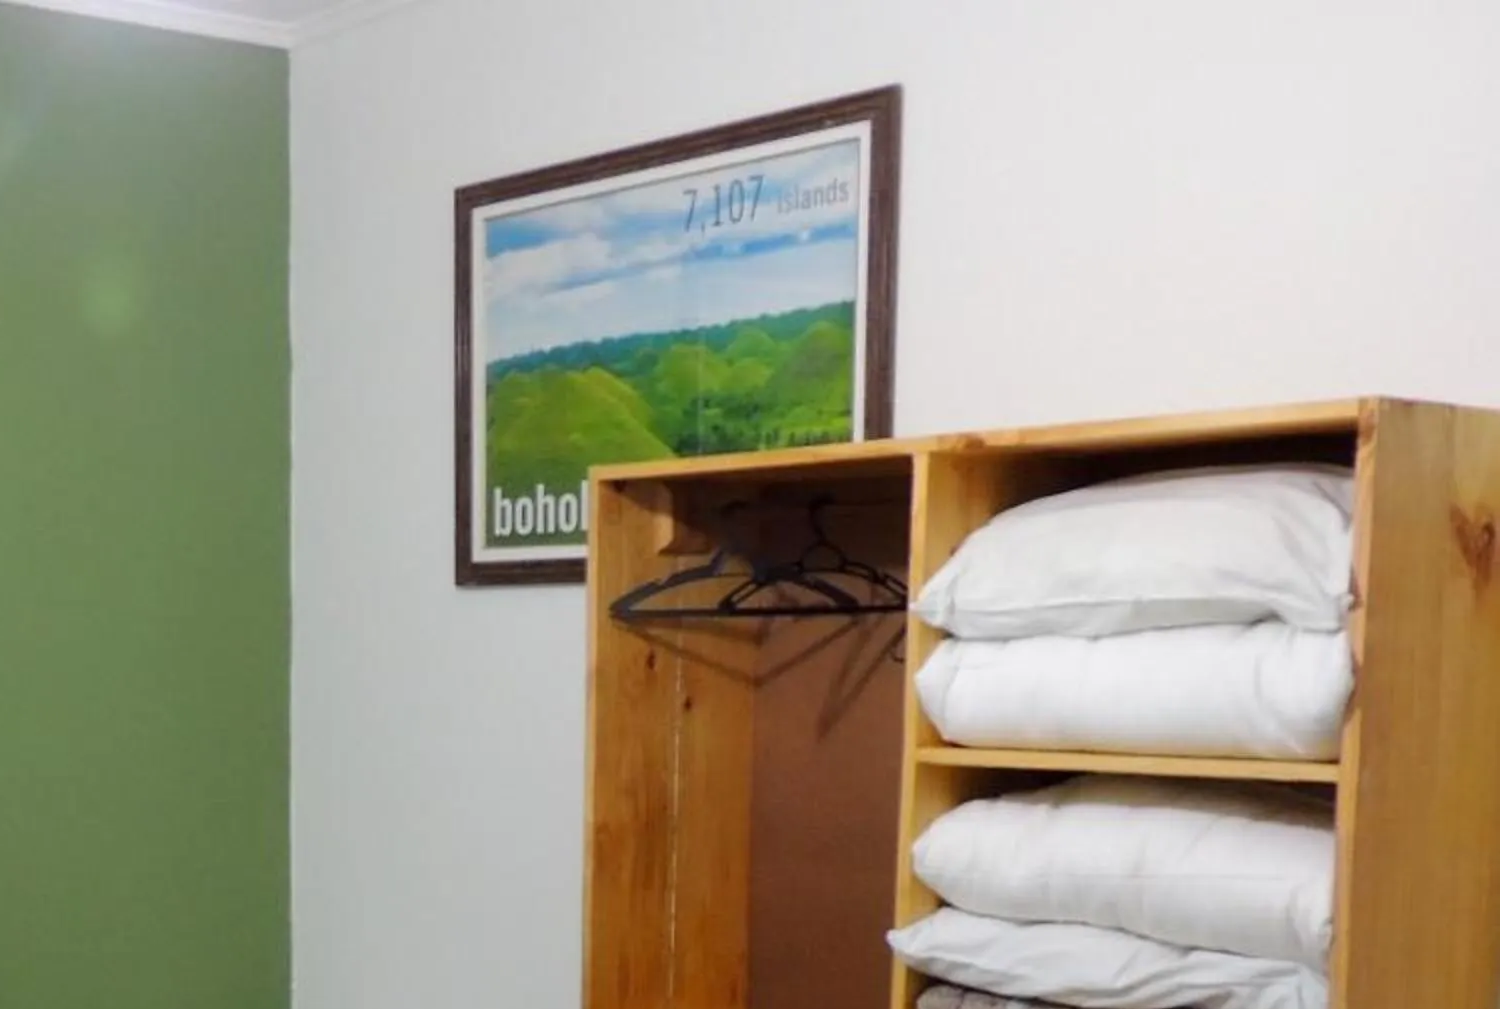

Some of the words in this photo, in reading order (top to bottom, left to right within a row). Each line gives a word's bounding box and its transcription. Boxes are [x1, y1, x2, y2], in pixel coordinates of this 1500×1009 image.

[683, 175, 764, 236] 7,107
[777, 178, 849, 214] islands
[494, 479, 589, 537] bohol
